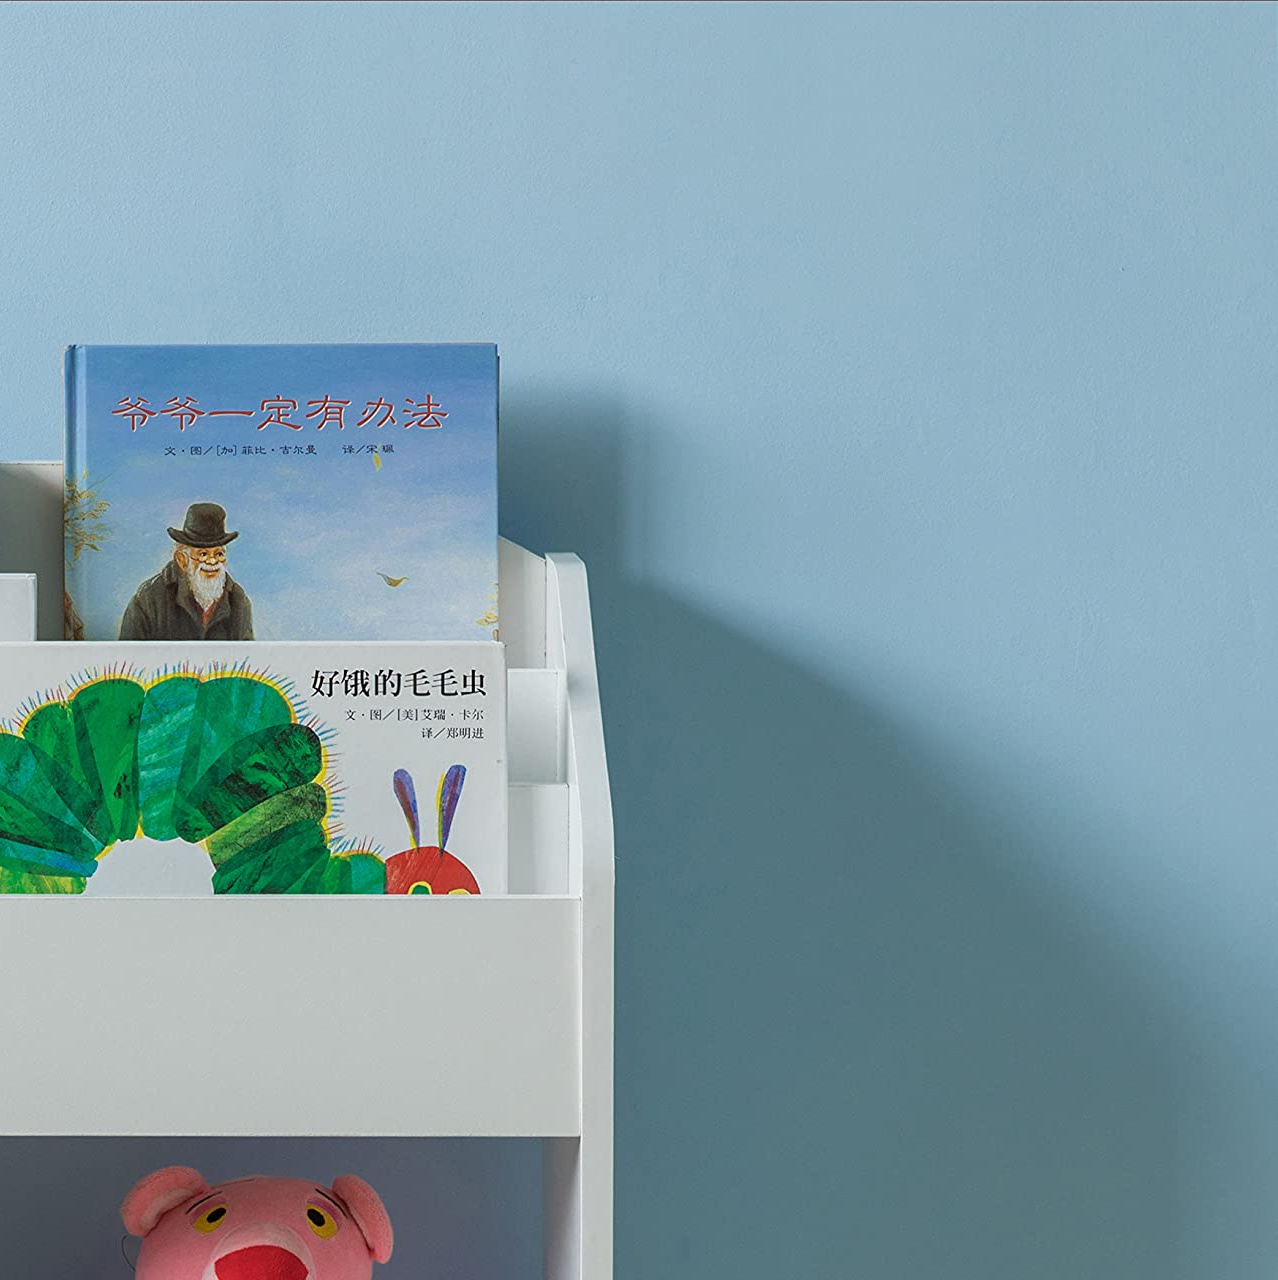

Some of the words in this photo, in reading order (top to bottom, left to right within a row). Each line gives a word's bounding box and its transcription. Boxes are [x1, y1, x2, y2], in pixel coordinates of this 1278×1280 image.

[112, 394, 449, 431] 爷爷一定有办法
[311, 669, 487, 697] 好饿的毛毛虫
